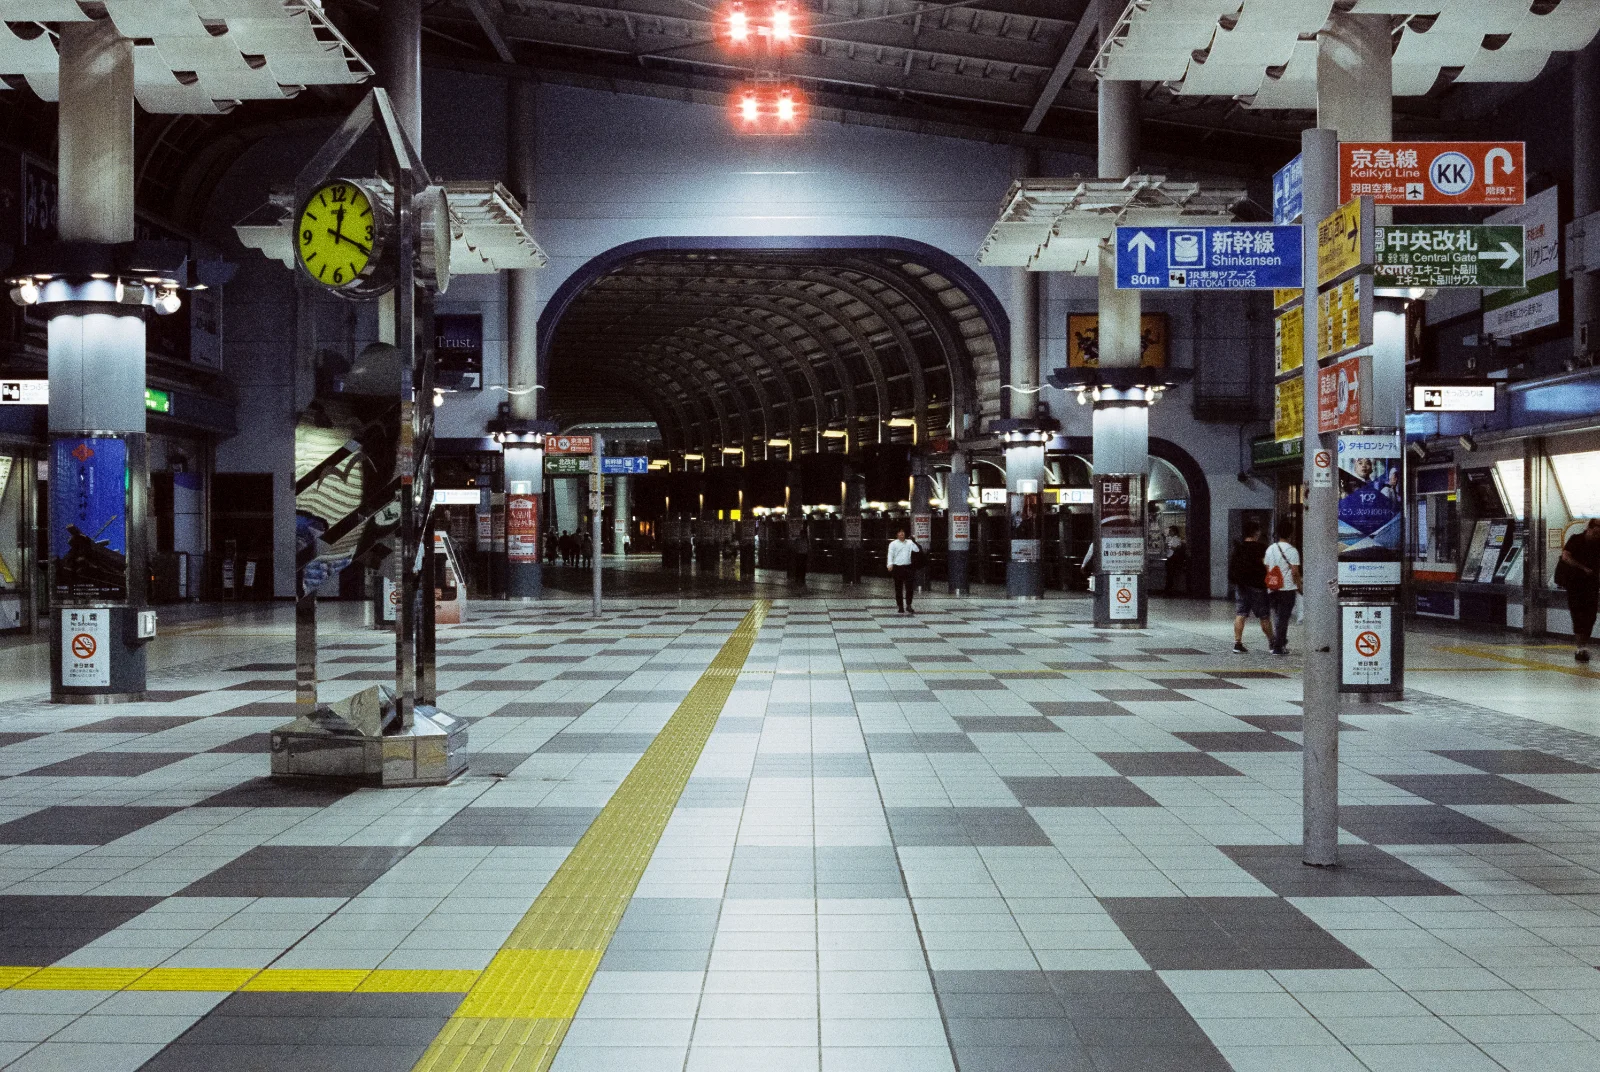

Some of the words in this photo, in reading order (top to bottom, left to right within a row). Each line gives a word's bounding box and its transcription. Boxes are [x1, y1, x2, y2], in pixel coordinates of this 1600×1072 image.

[1351, 149, 1418, 168] 京急線
[1395, 169, 1420, 178] Line
[1437, 164, 1465, 183] KK
[331, 186, 346, 202] 12
[303, 230, 312, 245] 9
[365, 226, 374, 241] 3
[1388, 230, 1477, 251] 中央改札
[1212, 231, 1274, 253] 新幹線
[1212, 255, 1281, 266] Shinkansen
[1413, 253, 1450, 262] Central
[1453, 253, 1477, 262] Gate
[334, 268, 343, 283] 6
[1414, 265, 1477, 275] エキュート品川
[1131, 275, 1160, 285] 80m
[1188, 279, 1199, 287] JR
[1200, 279, 1225, 287] TOKAI
[1228, 279, 1256, 287] TOURS
[1103, 483, 1122, 493] 日産
